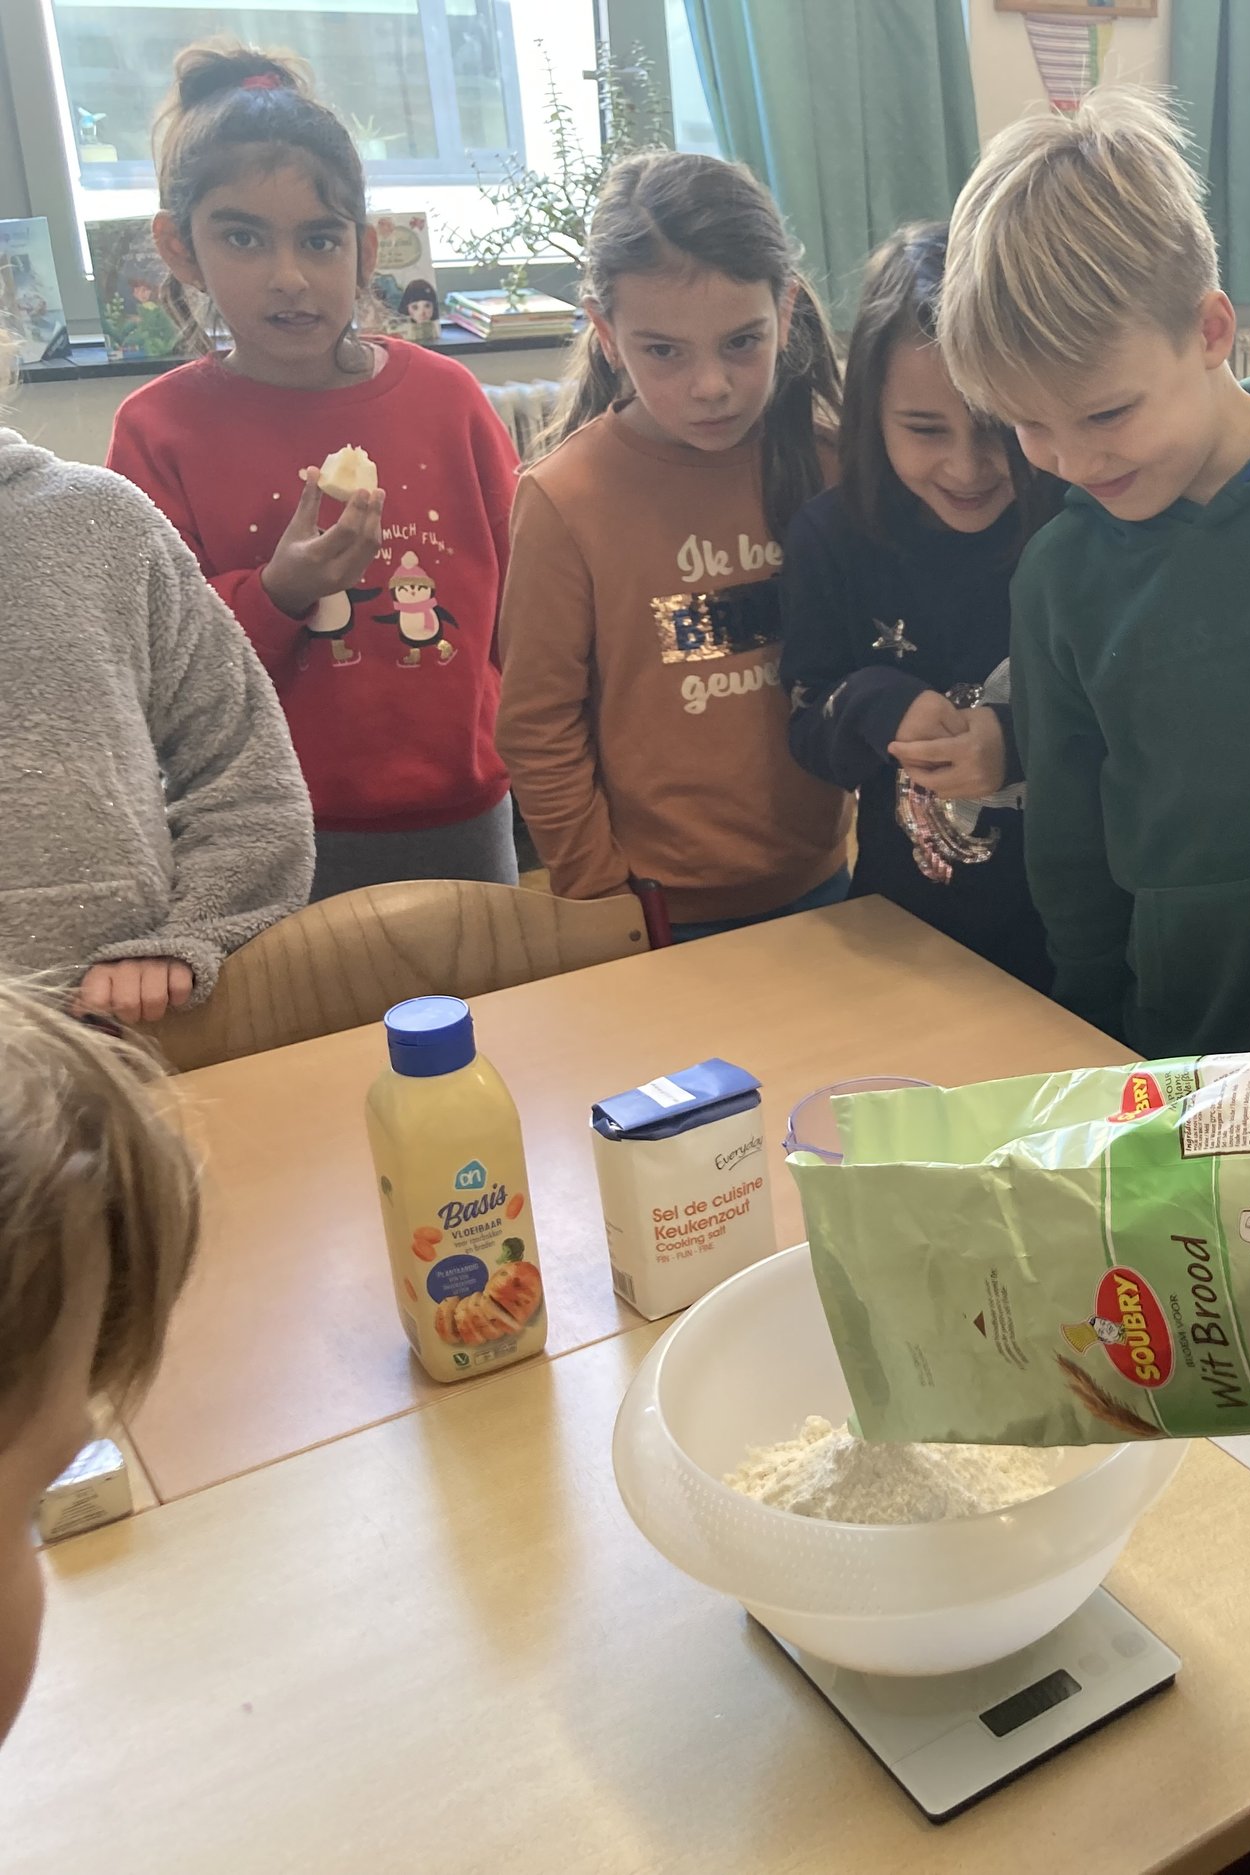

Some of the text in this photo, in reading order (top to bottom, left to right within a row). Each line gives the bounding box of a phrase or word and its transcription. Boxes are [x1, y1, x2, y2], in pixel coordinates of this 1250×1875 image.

[382, 523, 445, 552] MUCH FUN
[677, 534, 783, 583] Ik be
[681, 662, 782, 715] gewe
[437, 1183, 508, 1230] Basis
[652, 1176, 764, 1223] Sel de cuisine
[654, 1198, 751, 1241] Keukenzout
[452, 1218, 503, 1240] VLOEIBAAR
[656, 1225, 727, 1253] Cooking salt
[1113, 1273, 1161, 1381] SOUBRY
[1169, 1293, 1196, 1368] BLOEM VOOR
[1171, 1235, 1249, 1409] Wit Brood
